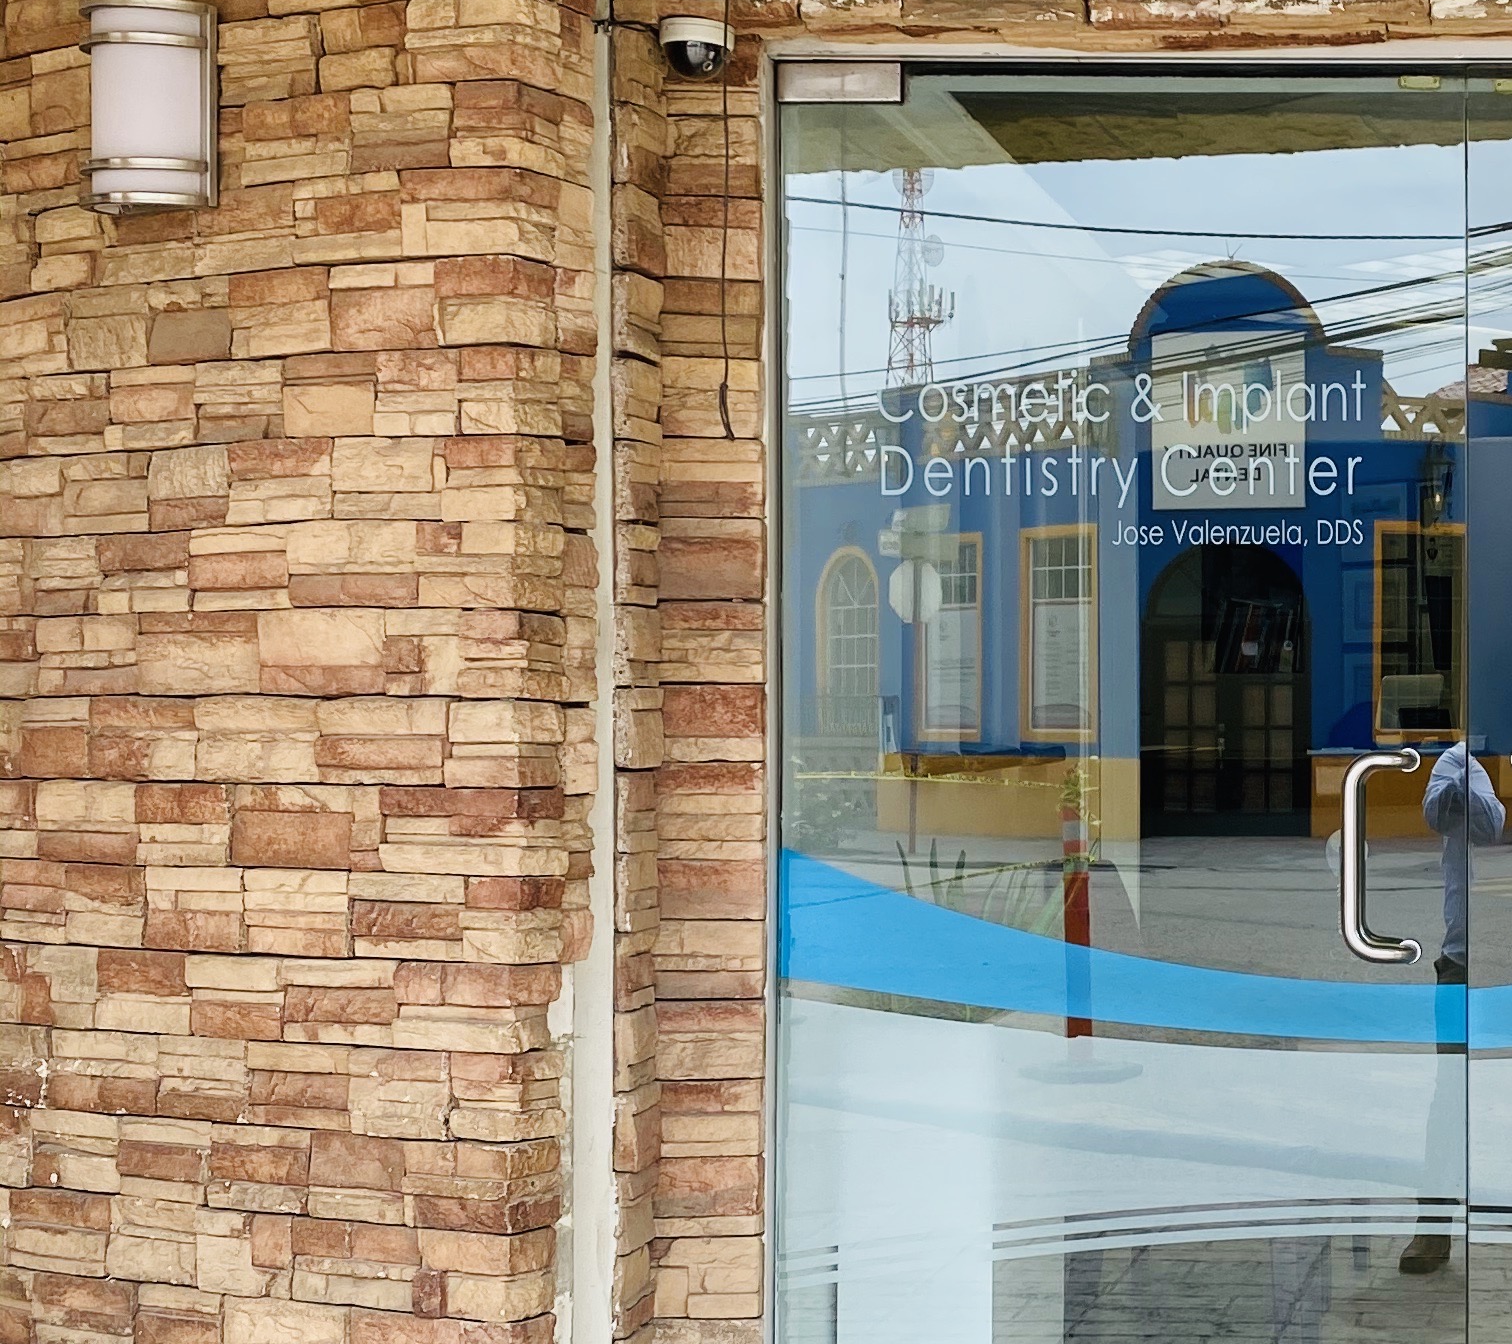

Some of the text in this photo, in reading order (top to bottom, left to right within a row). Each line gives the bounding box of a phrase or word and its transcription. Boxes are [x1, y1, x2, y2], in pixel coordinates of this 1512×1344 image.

[878, 369, 1366, 433] Cosmetic & Implant
[880, 443, 1362, 508] Dentistry Center
[1112, 519, 1363, 549] Jose Valenzuela, DDS
